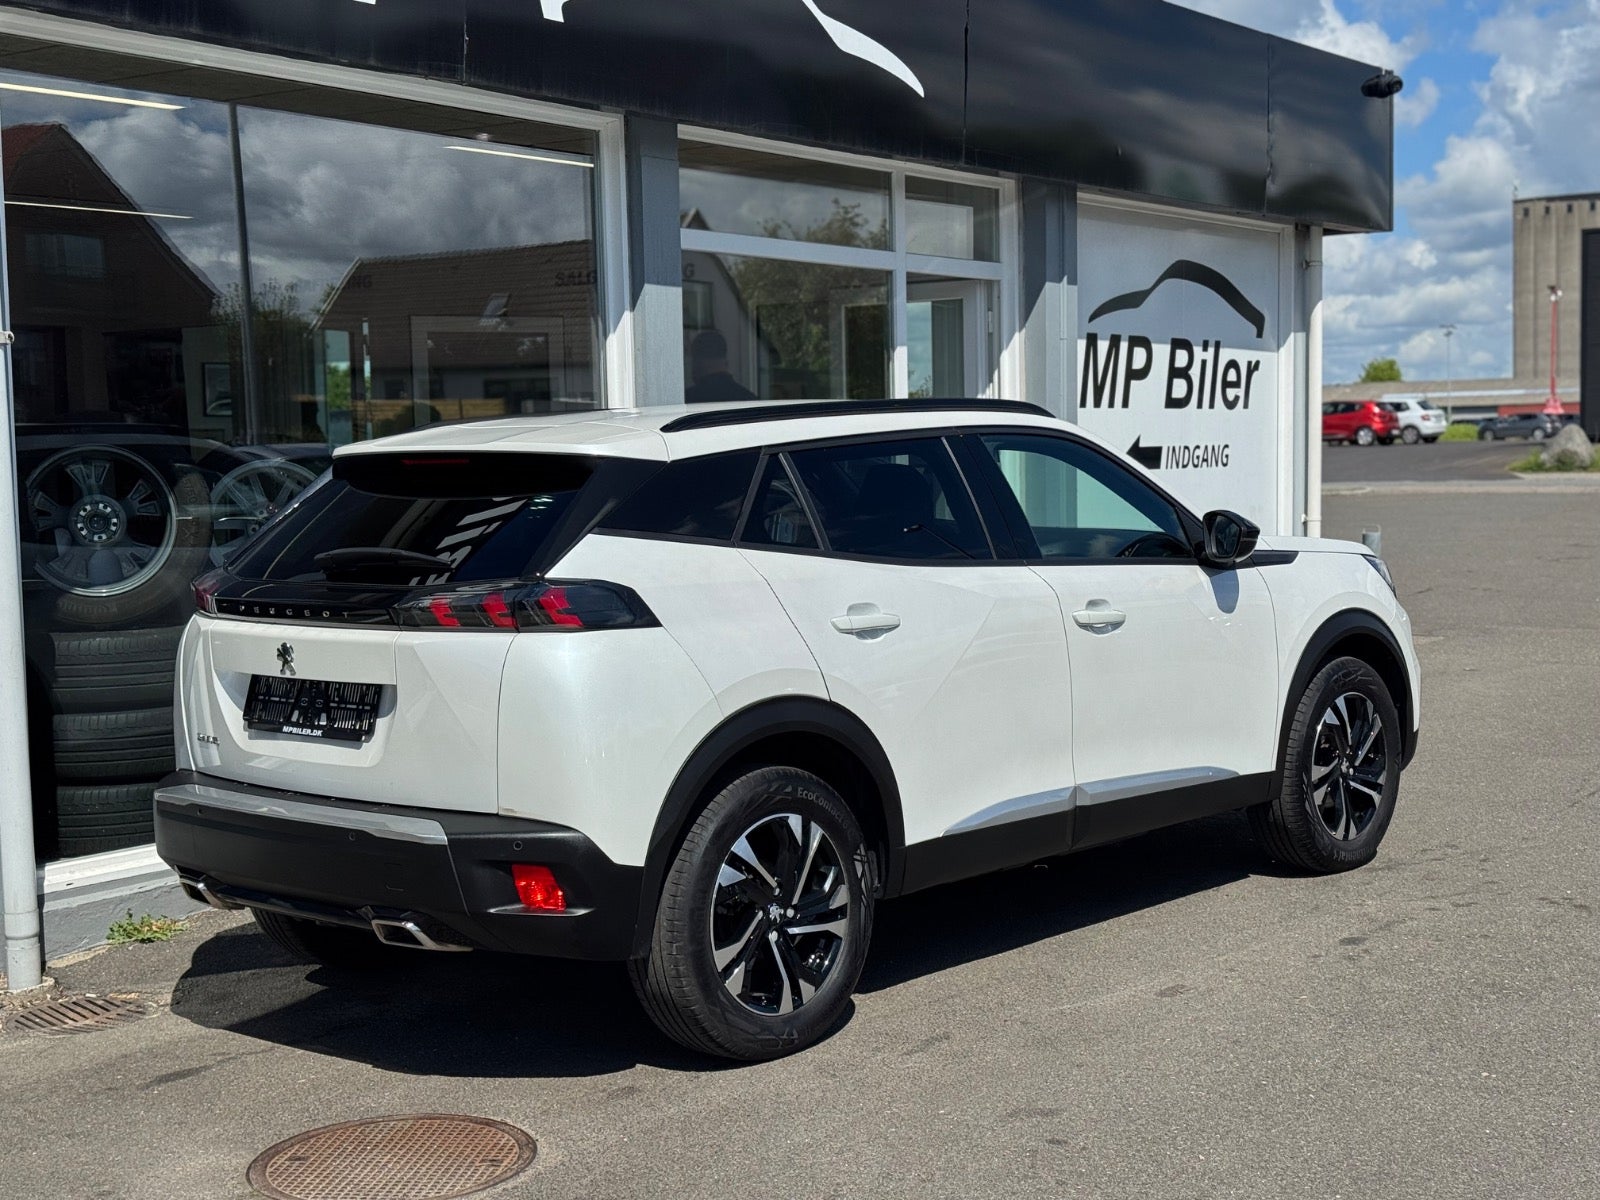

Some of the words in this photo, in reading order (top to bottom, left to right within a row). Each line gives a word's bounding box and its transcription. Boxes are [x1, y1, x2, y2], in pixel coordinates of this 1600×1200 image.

[1079, 332, 1153, 409] MP
[1164, 337, 1261, 411] Biler
[1165, 444, 1230, 470] INDGANG
[239, 604, 349, 619] PEUGEOT
